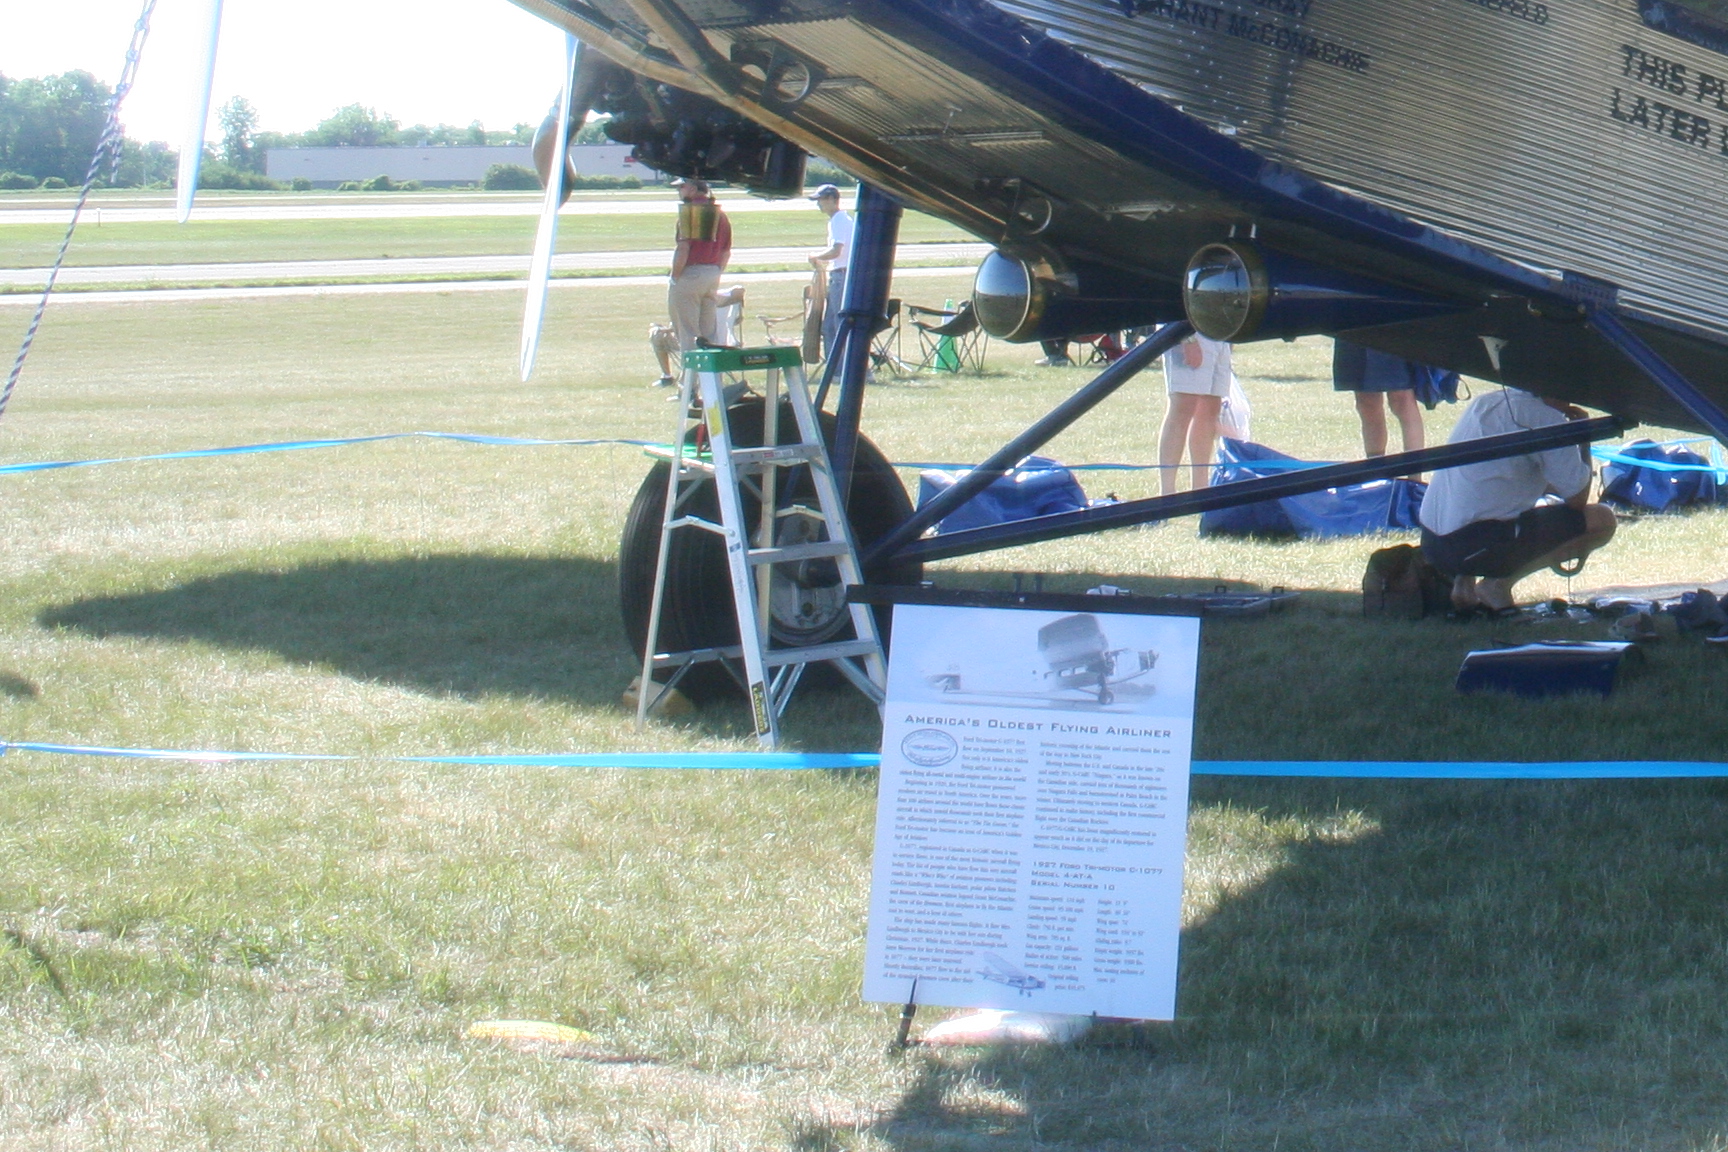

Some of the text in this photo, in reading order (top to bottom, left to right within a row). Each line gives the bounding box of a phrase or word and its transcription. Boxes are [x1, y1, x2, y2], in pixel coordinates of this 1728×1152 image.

[1227, 12, 1372, 74] McCONACHIE
[1621, 43, 1688, 96] THIS
[1611, 87, 1710, 150] LATER
[904, 714, 1172, 739] AMERICA'S OLDEST FLYING AIRLINER
[1103, 883, 1116, 891] 10
